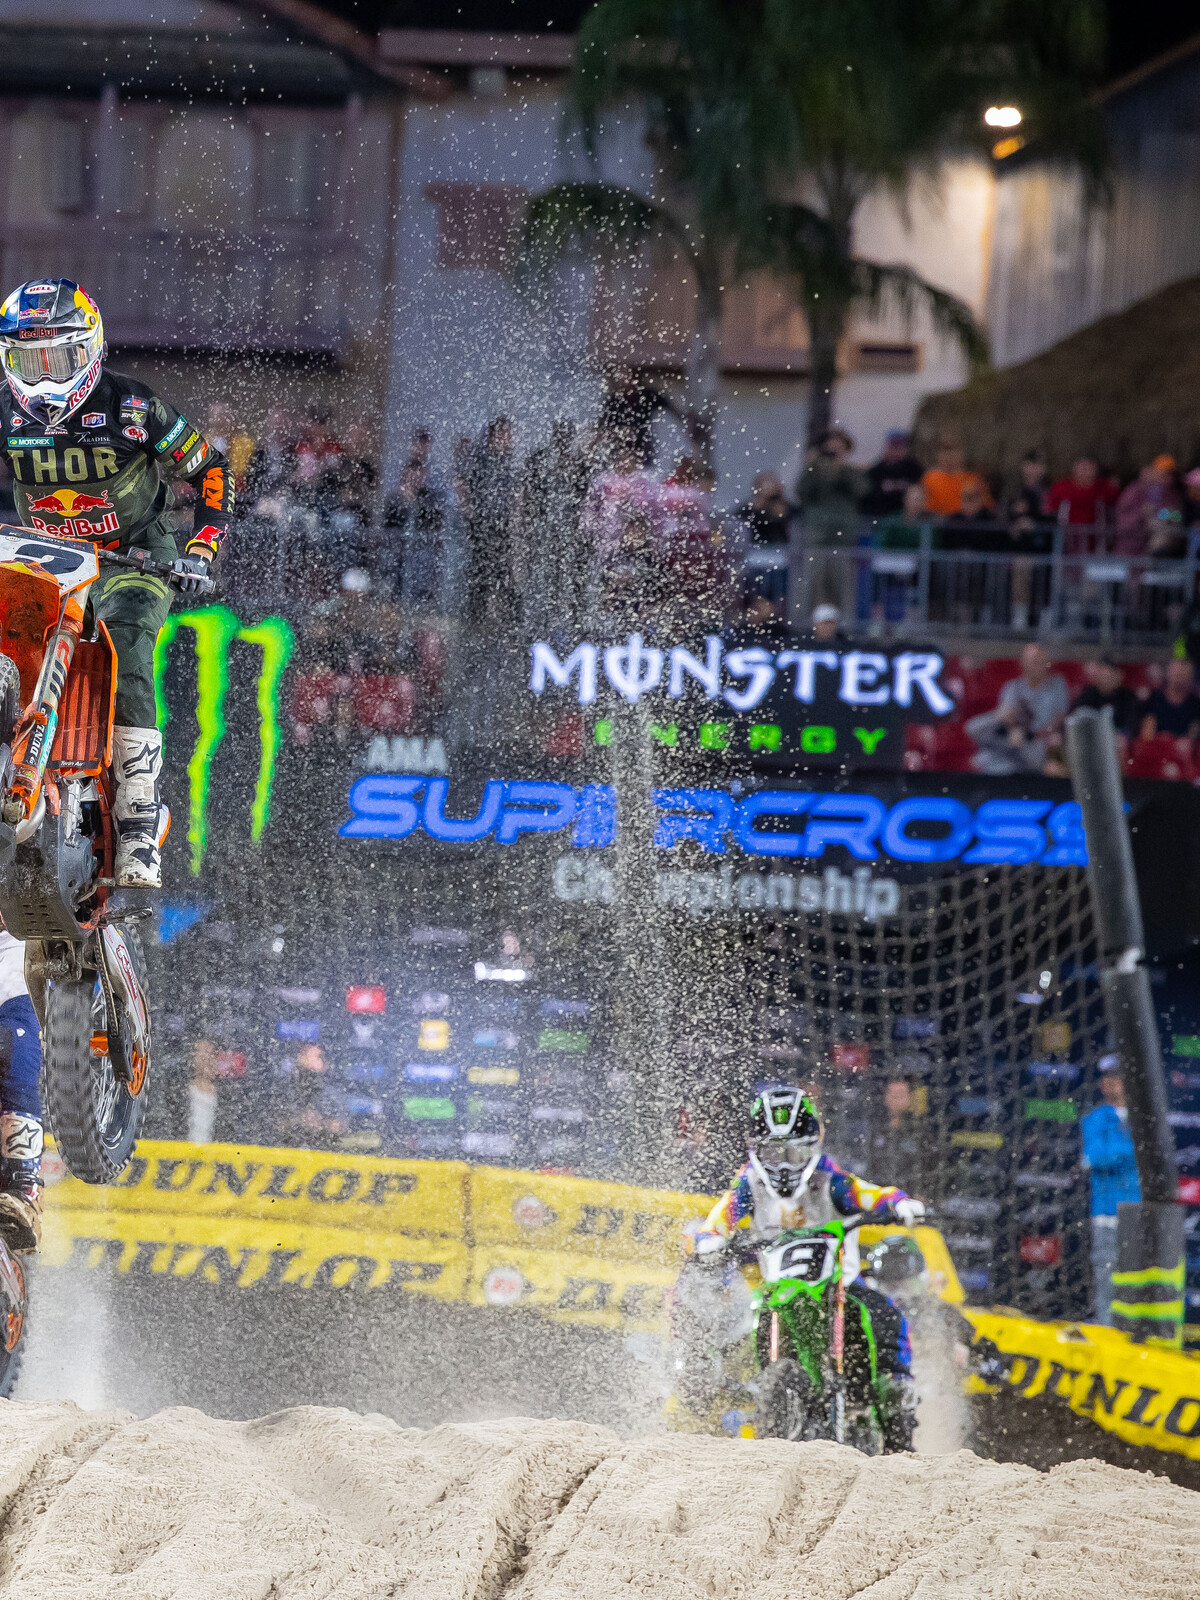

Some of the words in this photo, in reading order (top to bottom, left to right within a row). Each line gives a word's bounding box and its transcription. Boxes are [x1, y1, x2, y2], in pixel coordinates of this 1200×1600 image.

[20, 329, 38, 338] Red
[39, 327, 57, 337] Bull
[18, 438, 50, 446] MOTOREX
[6, 446, 120, 483] THOR
[202, 466, 224, 511] KTM
[31, 515, 74, 537] Red
[73, 512, 120, 537] Bull
[29, 706, 47, 759] DUNLP
[779, 1241, 830, 1281] 9
